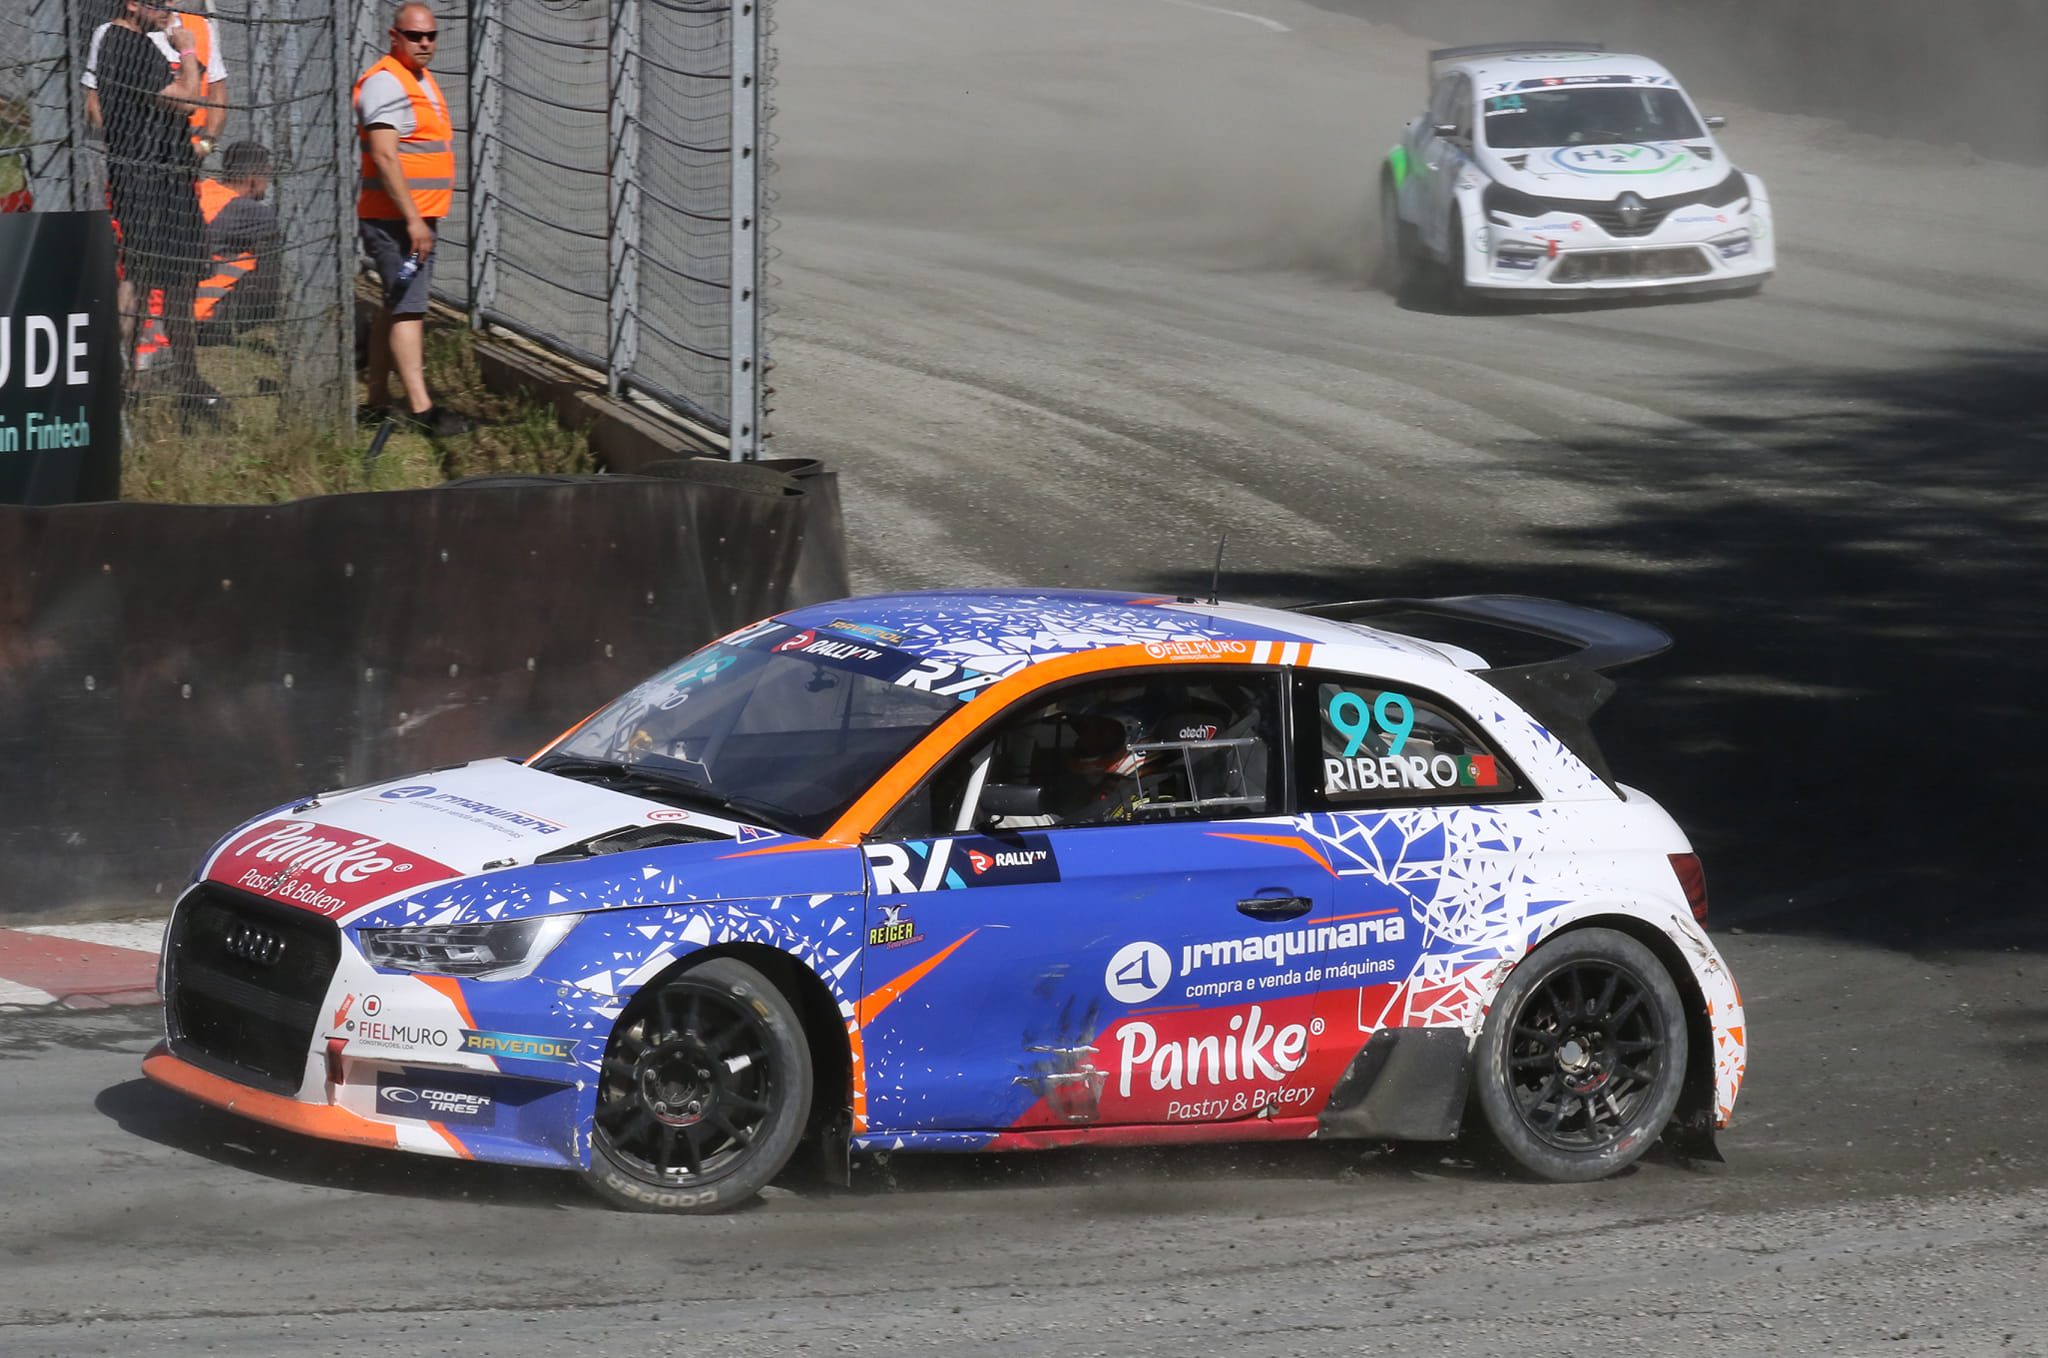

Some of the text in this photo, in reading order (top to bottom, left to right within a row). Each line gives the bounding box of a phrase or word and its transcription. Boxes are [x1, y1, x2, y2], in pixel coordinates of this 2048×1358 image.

[26, 405, 91, 451] Fintech
[829, 621, 905, 643] RAVENOL
[1163, 641, 1247, 655] FIELMURO
[1329, 691, 1415, 757] 99
[1324, 755, 1458, 790] RIBEIRO
[279, 880, 298, 896] &
[291, 883, 347, 915] Bakery
[869, 923, 913, 945] REIGER
[1186, 958, 1395, 998] compra e venda de máquinas
[359, 1021, 448, 1047] FIELMURO
[468, 1036, 567, 1058] RAVENOL
[421, 1090, 491, 1106] COOPER
[430, 1101, 479, 1115] TIRES
[1167, 1085, 1316, 1120] Pastry & Bakery
